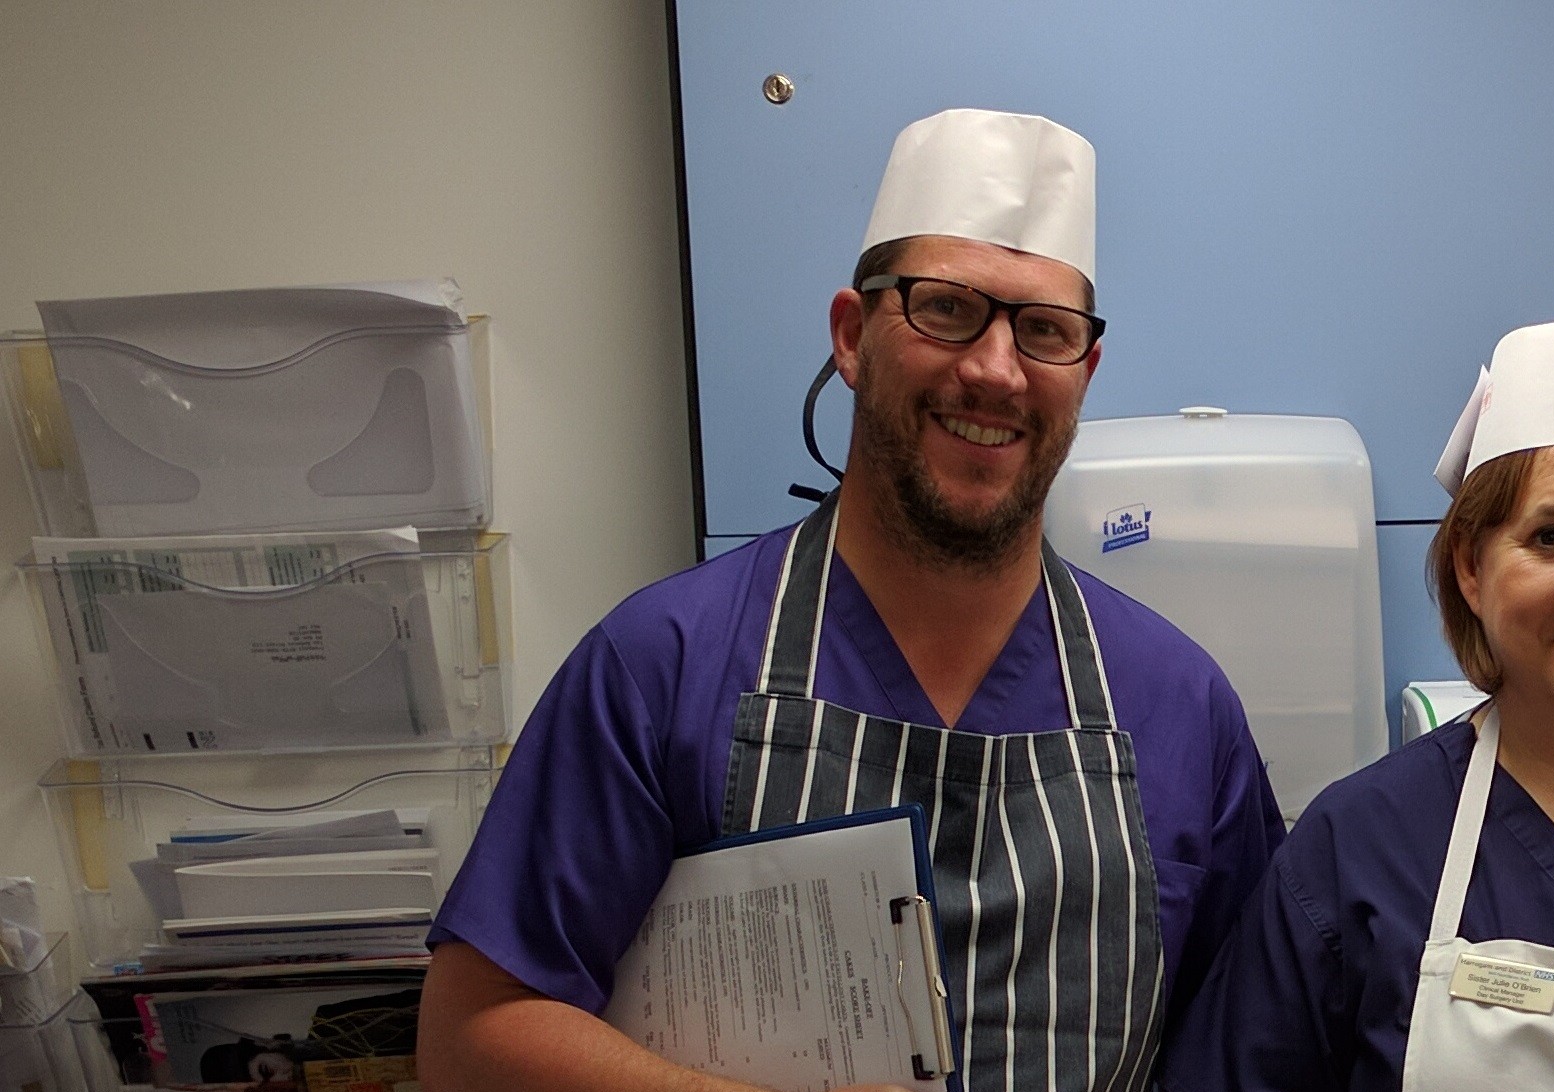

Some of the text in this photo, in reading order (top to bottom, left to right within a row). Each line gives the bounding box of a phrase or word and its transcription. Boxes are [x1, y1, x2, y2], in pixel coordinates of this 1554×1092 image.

[1111, 521, 1143, 535] lotus
[1468, 973, 1490, 983] Sister
[1492, 979, 1510, 987] Julie
[1512, 982, 1541, 993] O'Brien
[850, 986, 860, 1014] SCORE
[854, 1013, 864, 1040] SHEET
